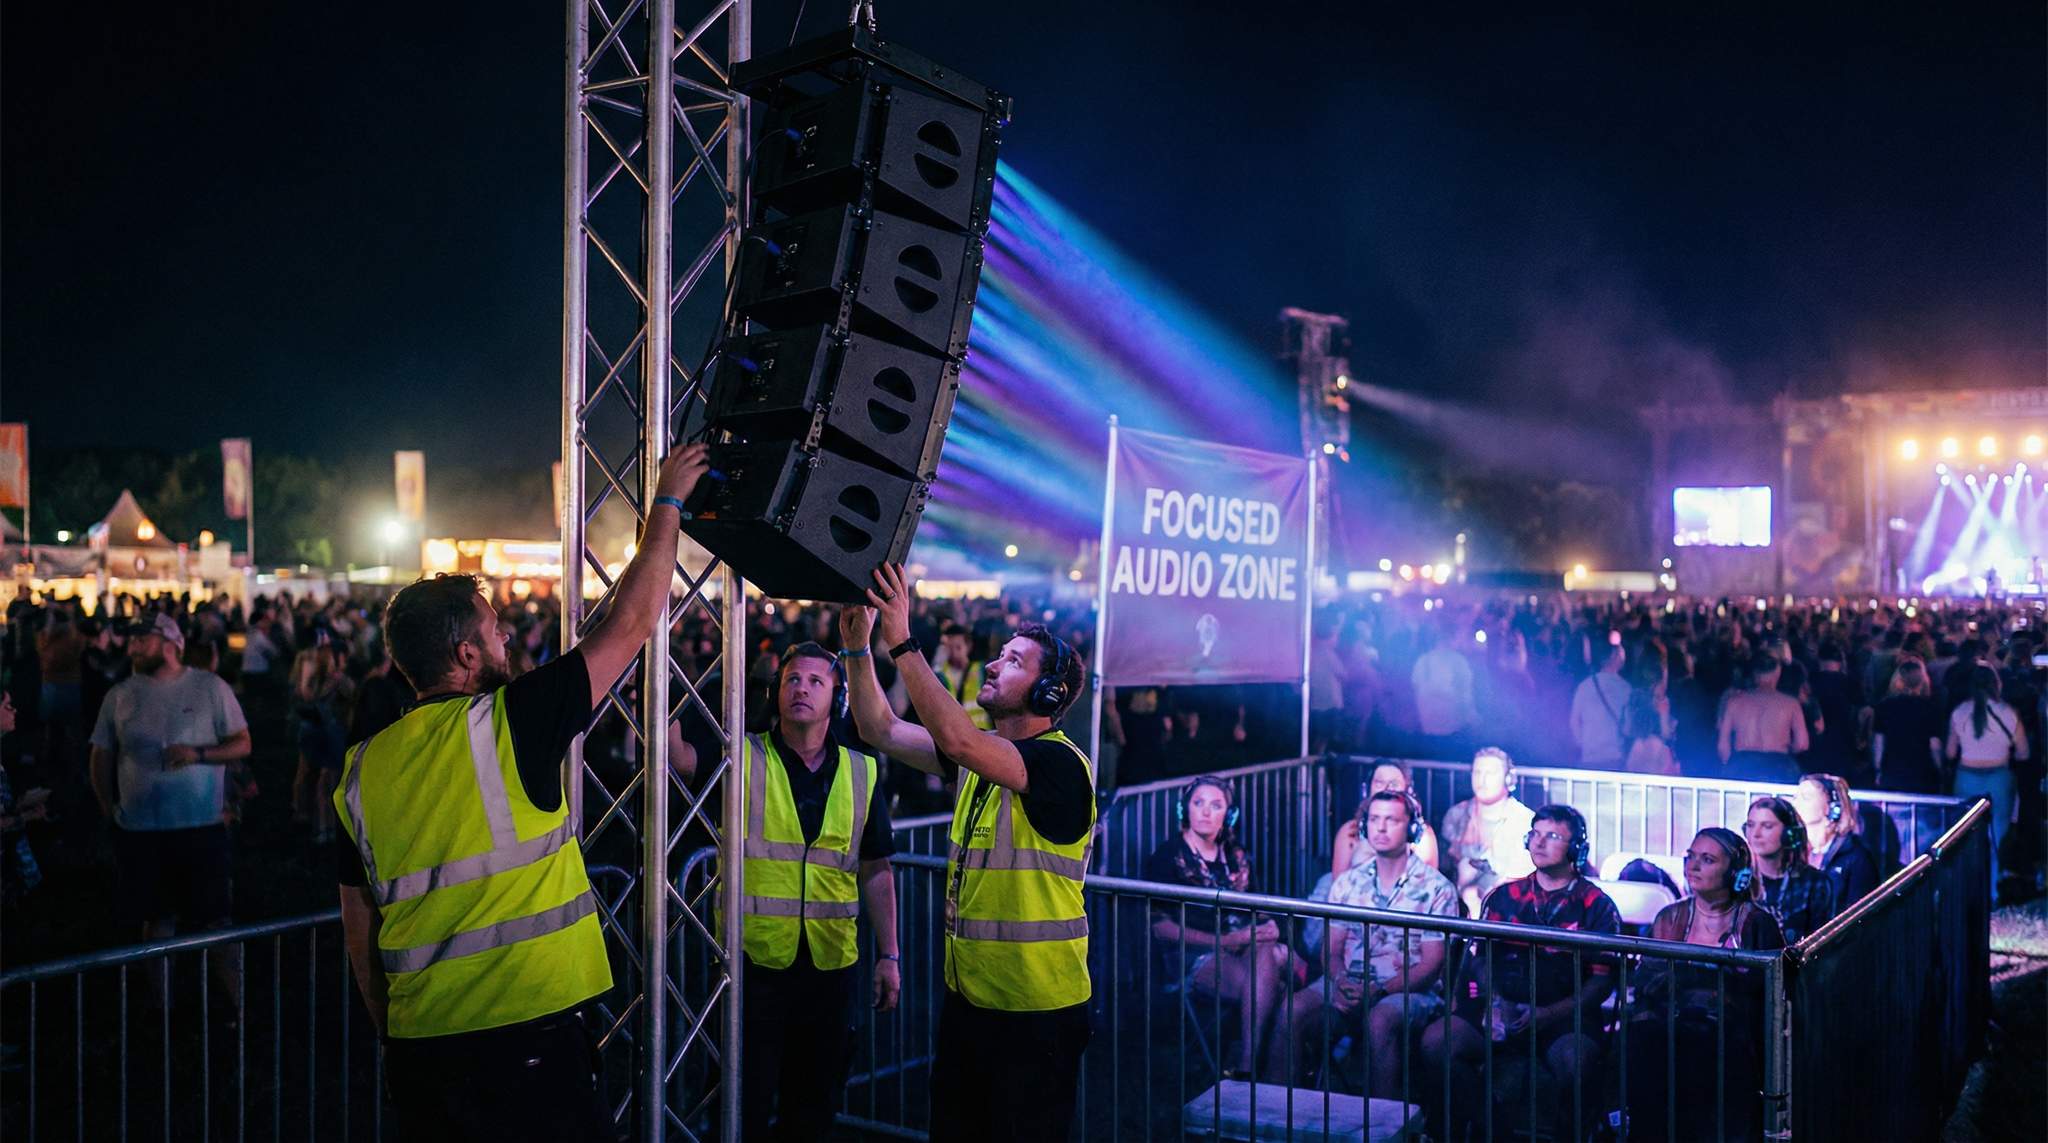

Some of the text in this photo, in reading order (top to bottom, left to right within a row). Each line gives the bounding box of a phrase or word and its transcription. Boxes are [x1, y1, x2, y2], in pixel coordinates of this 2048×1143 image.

[1142, 487, 1280, 545] FOCUSED
[1111, 545, 1296, 601] AUDIO ZONE
